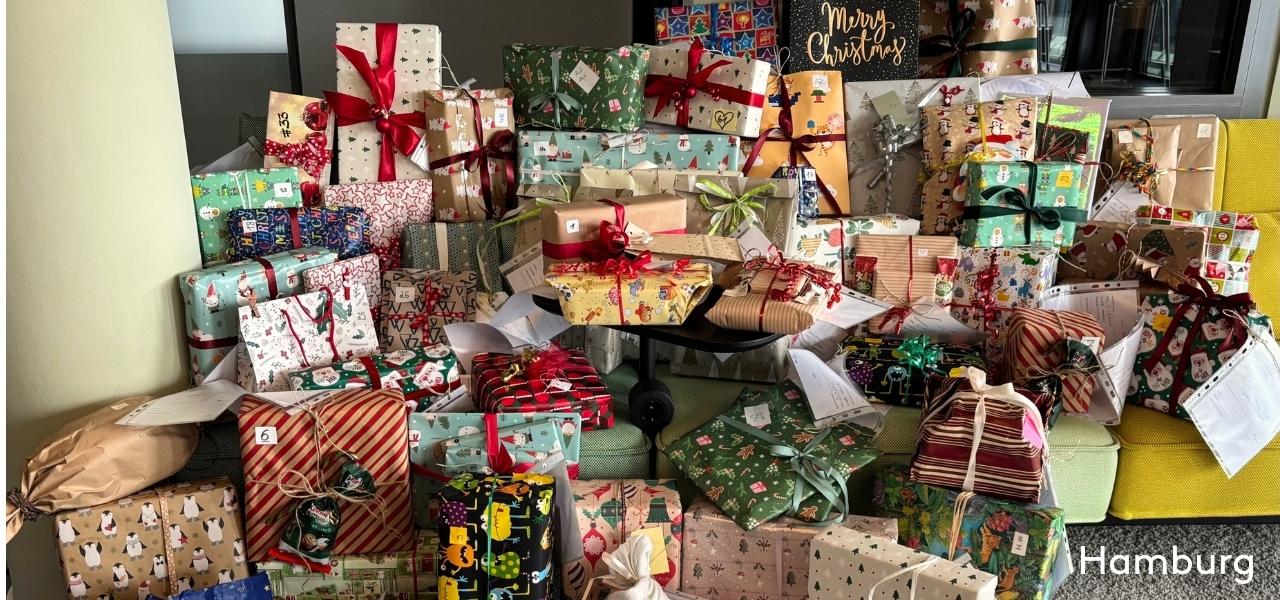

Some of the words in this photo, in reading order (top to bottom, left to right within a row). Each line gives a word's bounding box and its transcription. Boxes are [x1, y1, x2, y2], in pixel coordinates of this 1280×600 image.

[821, 2, 895, 44] Merry
[807, 29, 906, 66] Christmas
[278, 111, 291, 138] #33
[247, 221, 255, 231] 18
[399, 290, 409, 299] 26
[357, 312, 366, 321] 25
[260, 429, 270, 441] 6
